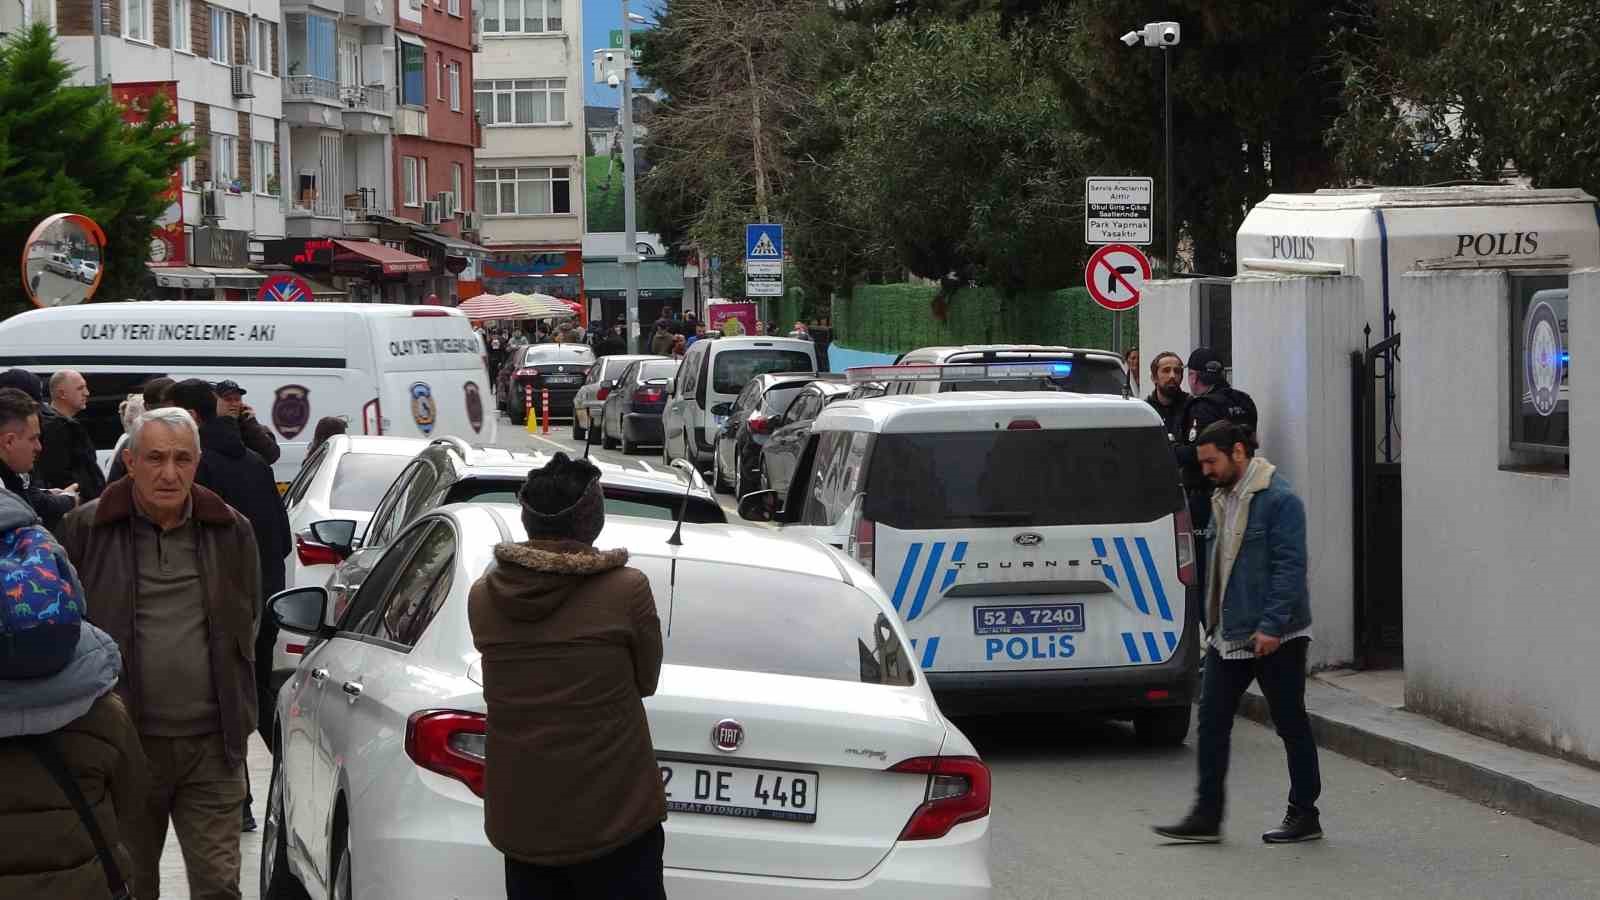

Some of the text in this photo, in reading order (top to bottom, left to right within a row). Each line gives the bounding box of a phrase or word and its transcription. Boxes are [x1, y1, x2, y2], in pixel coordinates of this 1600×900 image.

[1090, 220, 1148, 229] Park Yapmak
[1271, 235, 1315, 260] POLIS
[1454, 231, 1539, 257] POLIS
[80, 323, 118, 340] OLAY
[954, 559, 1103, 569] TOURNEO
[983, 609, 1075, 626] 52 A 7240
[720, 728, 737, 744] FIAT
[661, 765, 807, 809] 2 DE 448
